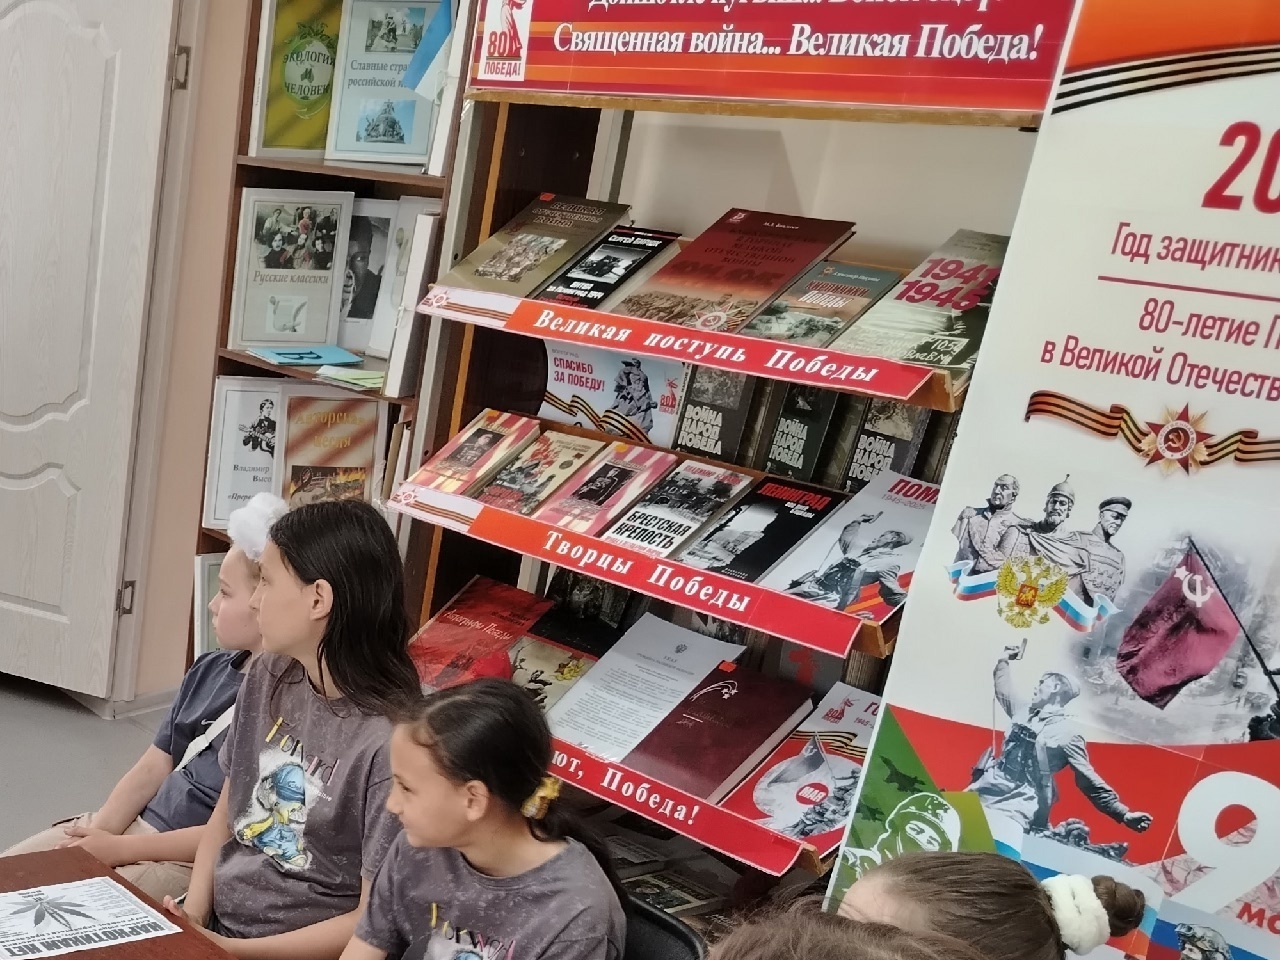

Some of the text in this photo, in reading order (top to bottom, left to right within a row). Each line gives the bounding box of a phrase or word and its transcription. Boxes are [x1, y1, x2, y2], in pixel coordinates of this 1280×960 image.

[553, 23, 1044, 64] Священная война... Великая Победа!
[283, 50, 335, 67] ЭКОЛОГИЯ
[351, 60, 408, 74] Славные стра
[484, 61, 521, 77] ПОБЕДА!
[284, 83, 330, 96] ЧЕЛОВЕК
[348, 77, 396, 89] российской
[1111, 221, 1153, 264] Год
[253, 271, 329, 285] Русские классики
[918, 257, 1002, 290] 1941
[894, 280, 990, 311] 1945
[1138, 297, 1261, 347] 80-летие
[533, 309, 880, 382] Великая поступь Победы
[553, 357, 594, 375] СПАСИБО
[1041, 340, 1057, 364] в
[1059, 334, 1165, 382] Великой
[553, 370, 605, 392] ЗА ПОБЕДУ!
[687, 404, 722, 427] ВОЙНА
[682, 417, 721, 439] НАРОД
[778, 418, 808, 440] ВОЙНА
[677, 430, 722, 455] ПОБЕДА
[773, 433, 805, 454] НАРОД
[859, 434, 895, 458] ВОЙНА
[233, 464, 270, 476] Владимир
[769, 449, 804, 469] ПОБЕДА
[252, 475, 272, 483] Высо
[758, 482, 832, 511] ЛЕНИНГРАД
[888, 478, 940, 504] ПОМ
[626, 510, 692, 537] БРЕСТСКАЯ
[612, 522, 676, 550] КРЕПОСТЬ
[543, 530, 635, 575] Творцы
[647, 564, 751, 613] Победы
[552, 750, 700, 825] ют, Победа!
[39, 921, 165, 952] НАРКОТИКАМ
[3, 943, 38, 957] НЕТ
